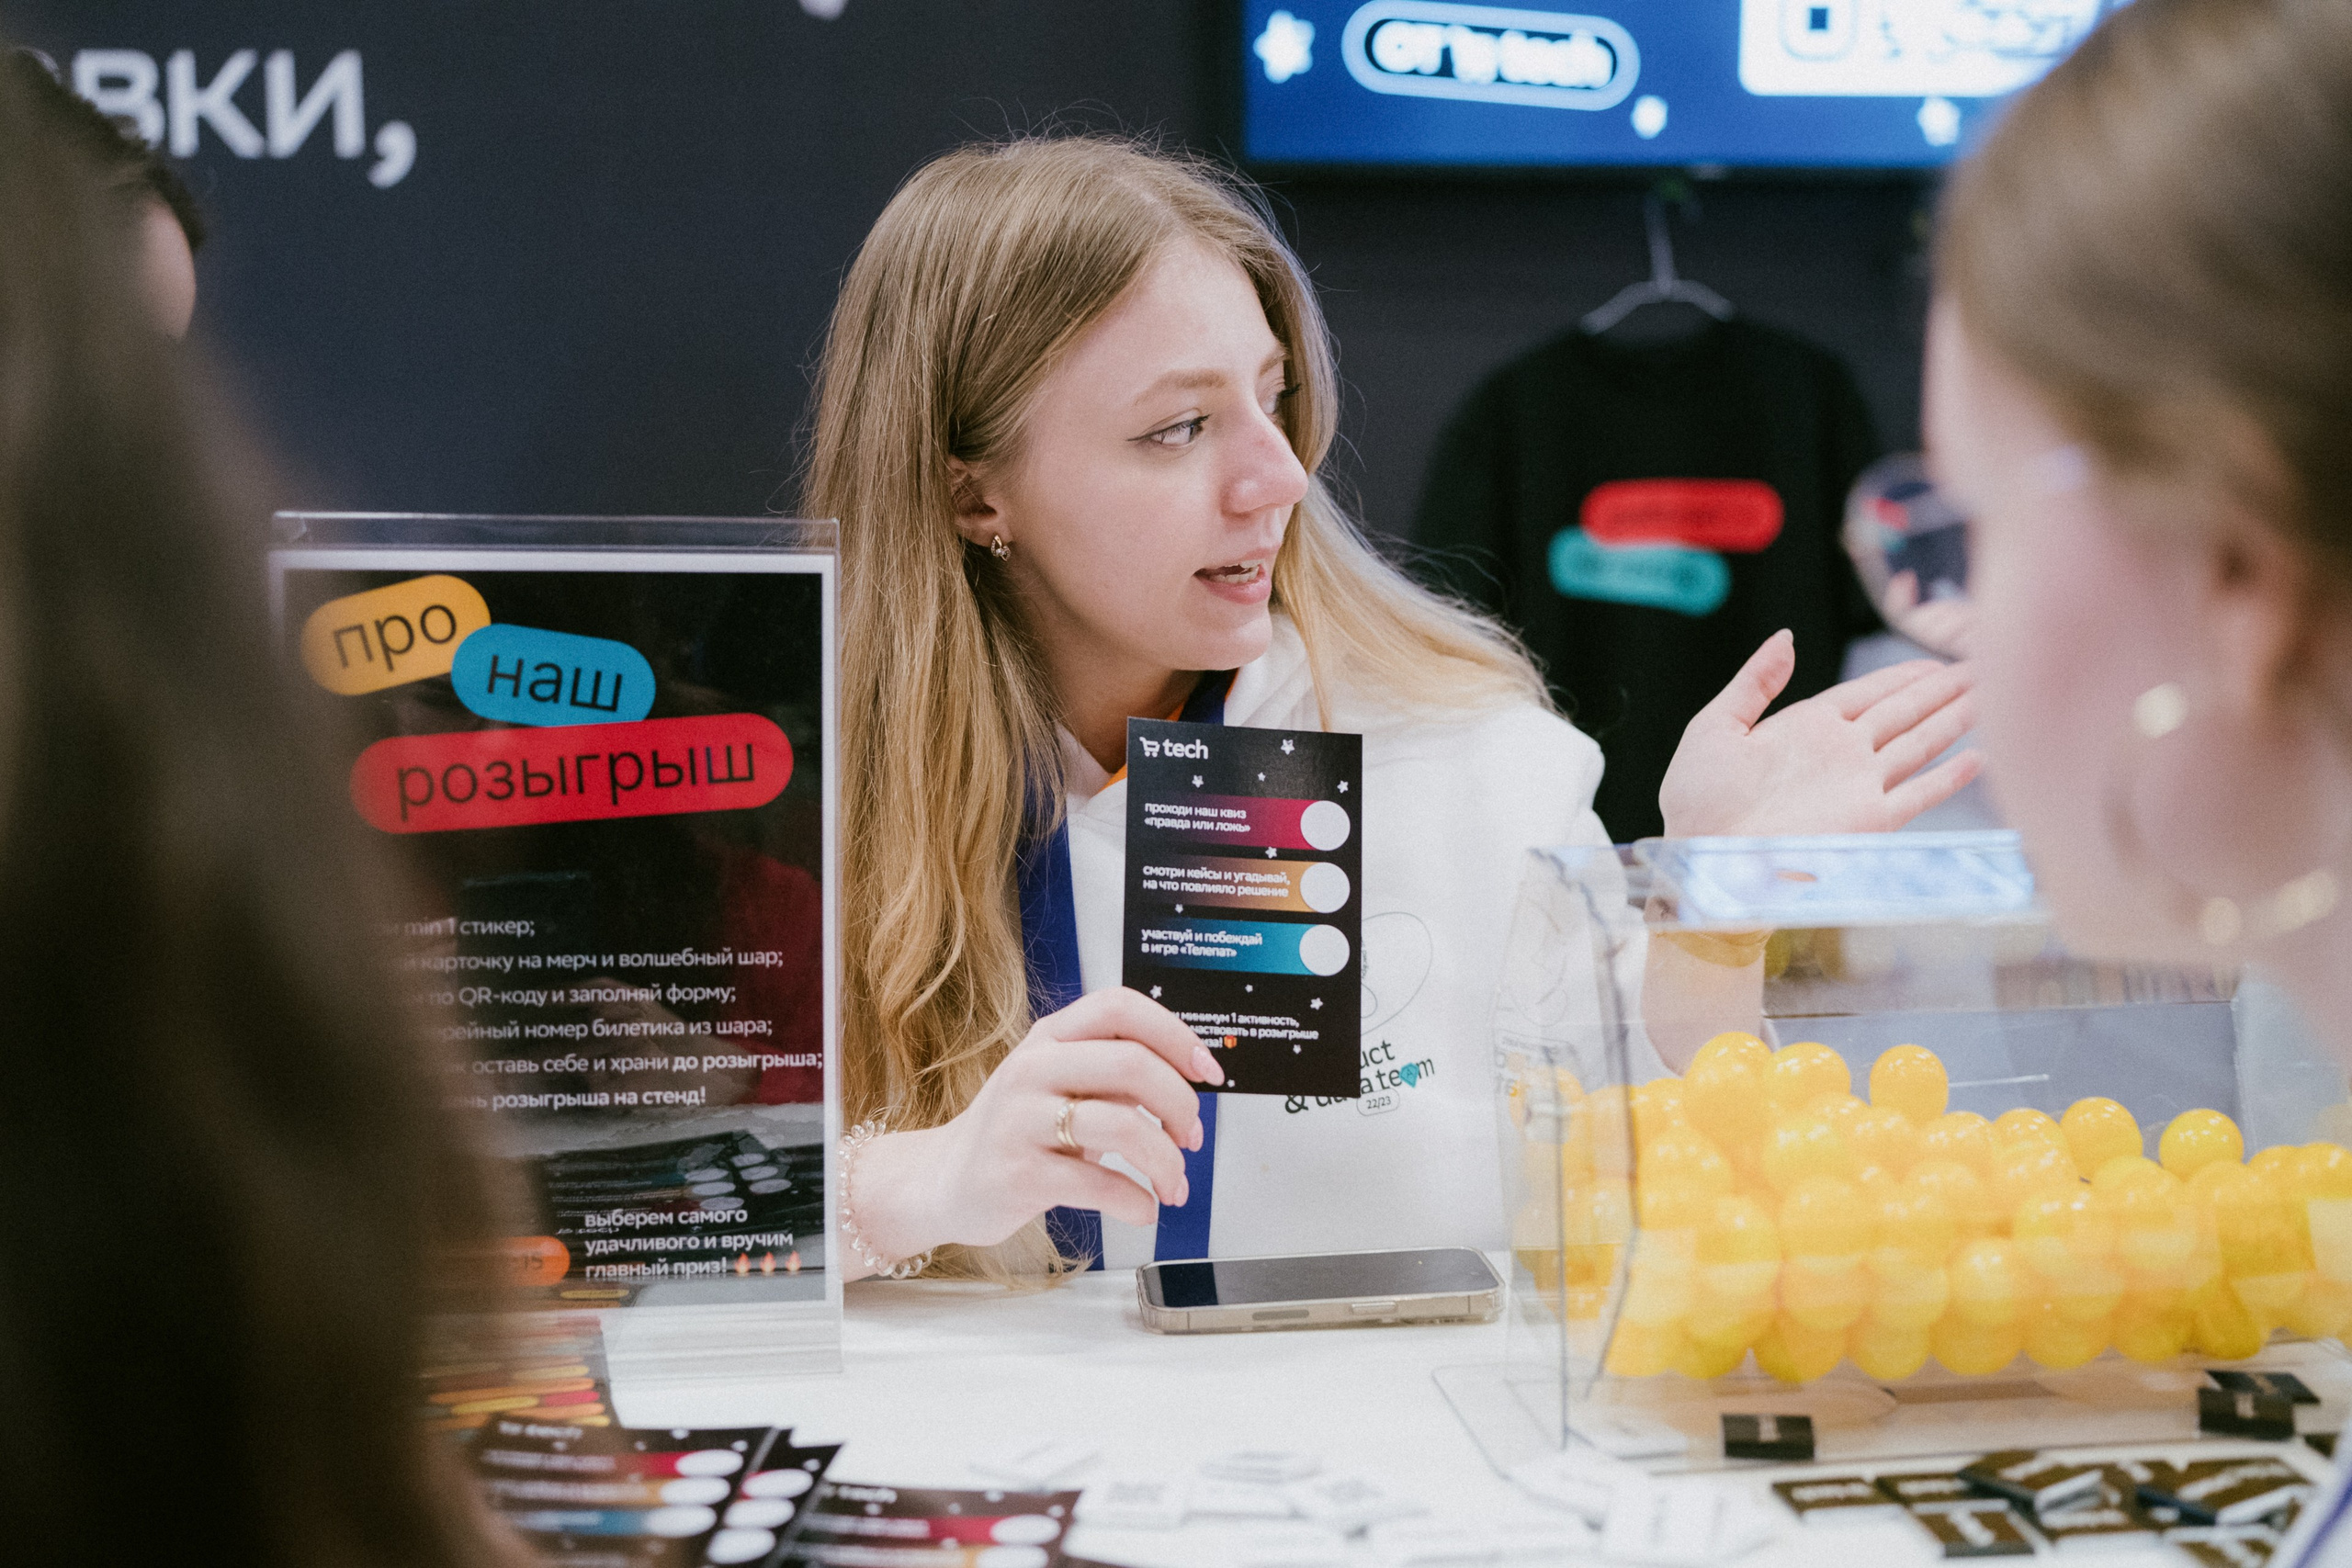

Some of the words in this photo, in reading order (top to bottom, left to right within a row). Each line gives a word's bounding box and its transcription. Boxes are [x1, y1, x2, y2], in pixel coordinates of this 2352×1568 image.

[14, 46, 418, 188] вки,
[333, 603, 458, 672] про
[485, 653, 624, 714] наш
[1162, 739, 1209, 761] tech
[395, 742, 757, 823] розыгрыш
[1144, 803, 1193, 817] проходи
[1194, 807, 1218, 818] наш
[1220, 808, 1247, 819] квиз
[1144, 817, 1191, 829] «правда
[1193, 820, 1215, 830] или
[1216, 822, 1251, 833] ложь»
[1142, 865, 1185, 878] смотри
[1187, 866, 1222, 881] кейсы
[1224, 871, 1232, 880] и
[1233, 871, 1291, 886] угадывай,
[1143, 879, 1158, 890] на
[1159, 881, 1180, 891] что
[1181, 882, 1236, 896] повлияло
[1238, 885, 1289, 897] решение
[459, 919, 536, 938] стикер;
[1141, 929, 1193, 943] участвуй
[1194, 931, 1203, 942] и
[1204, 931, 1262, 946] побеждай
[517, 955, 542, 968] на
[546, 953, 597, 971] мерч
[602, 953, 615, 967] и
[619, 947, 733, 967] волшебный
[738, 950, 784, 968] шар;
[1141, 944, 1149, 953] в
[1151, 944, 1179, 956] игре
[1180, 943, 1238, 958] «Телепат»
[458, 986, 548, 1009] QR-коду
[551, 989, 564, 1003] и
[569, 982, 662, 1005] заполняй
[666, 982, 737, 1004] форму;
[525, 1023, 589, 1041] номер
[592, 1018, 685, 1038] билетика
[689, 1021, 712, 1035] из
[717, 1020, 773, 1037] шара;
[1238, 1014, 1300, 1028] активность,
[1250, 1027, 1257, 1037] в
[1258, 1027, 1320, 1041] розыгрыше
[471, 1060, 539, 1075] оставь
[542, 1054, 589, 1073] себе
[594, 1058, 605, 1072] и
[610, 1056, 669, 1075] храни
[673, 1056, 698, 1072] до
[702, 1052, 824, 1073] розыгрыша;
[492, 1091, 610, 1111] розыгрыша
[614, 1090, 639, 1106] на
[642, 1086, 706, 1108] стенд!
[1366, 1095, 1392, 1111] 22/23
[583, 1208, 674, 1230] выберем
[677, 1208, 749, 1225] самого
[585, 1235, 700, 1258] удачливого
[704, 1236, 718, 1249] и
[721, 1232, 794, 1252] вручим
[585, 1258, 669, 1279] главный
[672, 1256, 728, 1276] приз!
